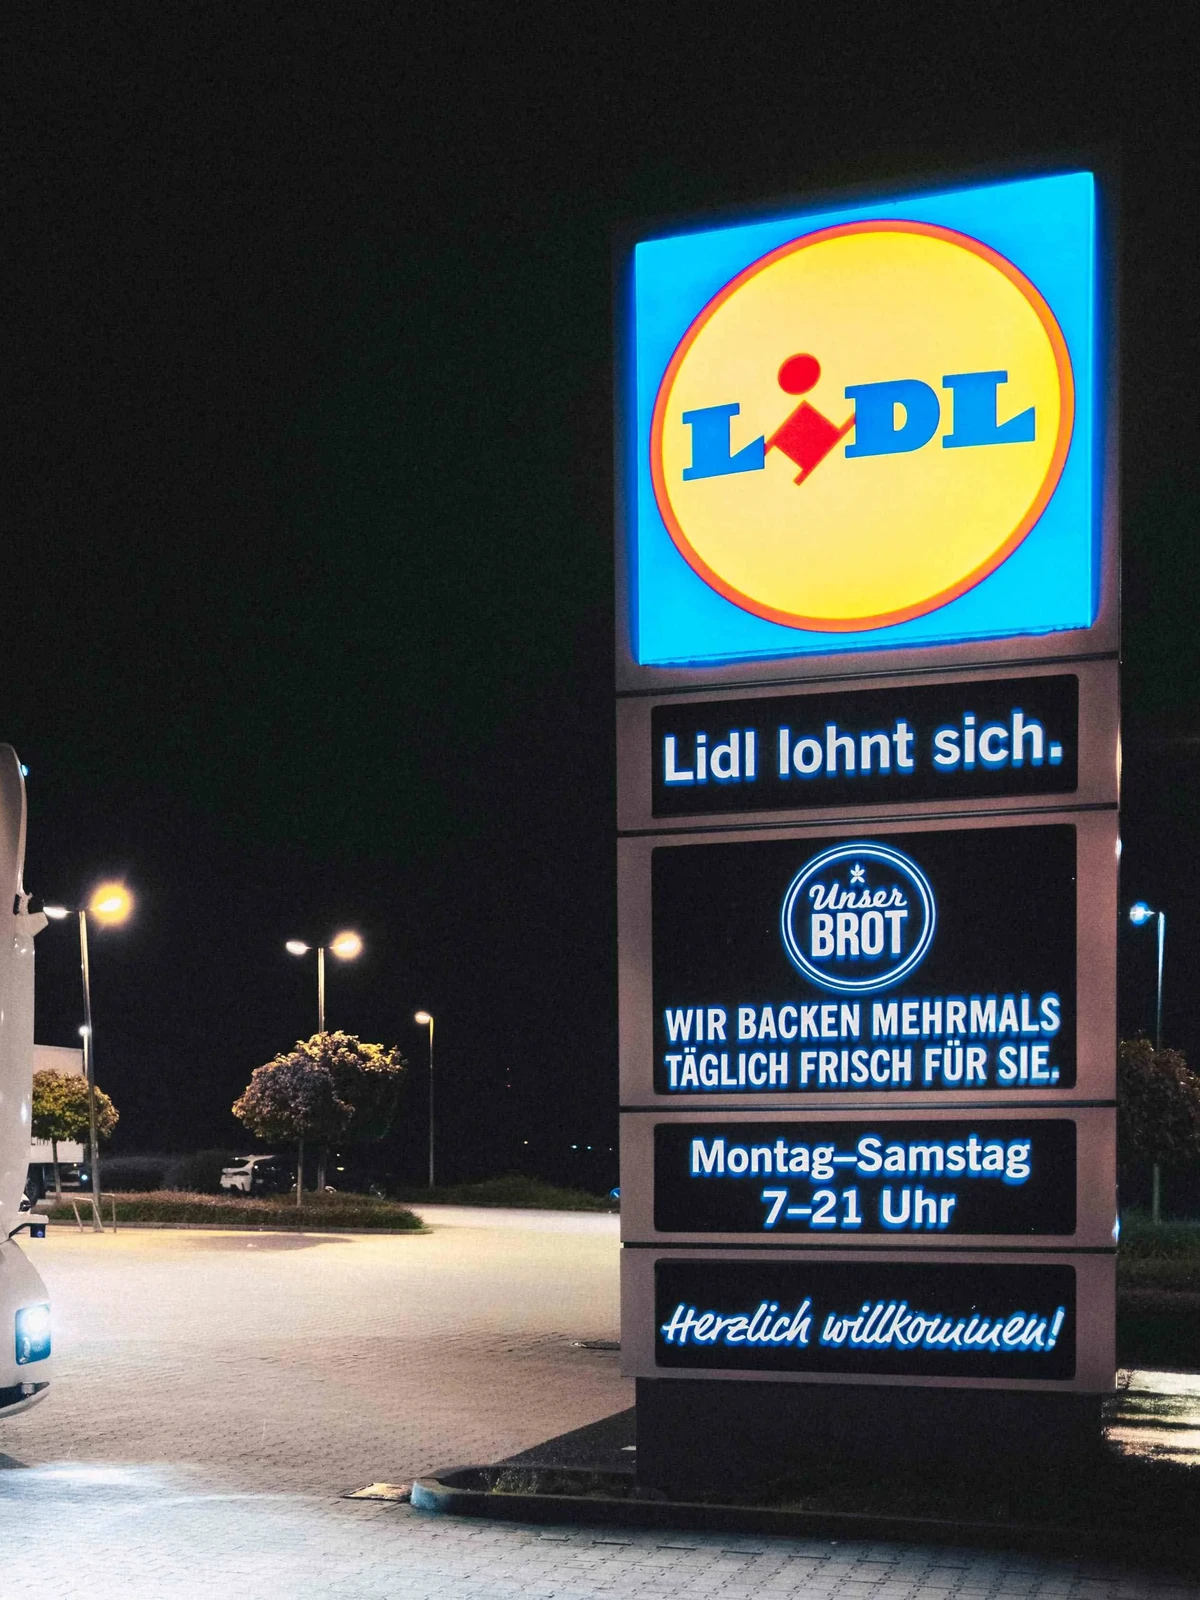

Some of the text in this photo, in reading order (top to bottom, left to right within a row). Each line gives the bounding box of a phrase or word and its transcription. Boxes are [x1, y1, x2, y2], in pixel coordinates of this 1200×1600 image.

[665, 713, 1062, 781] Lidl lohnt sich.
[809, 883, 907, 910] Unser
[811, 909, 908, 958] BROT
[665, 997, 1060, 1041] WIR BACKEN MEHRMALS
[665, 1039, 1060, 1086] TÄGLICH FRISCH FÜR SIE.
[763, 1190, 955, 1224] 7–21 Uhr
[663, 1301, 1065, 1347] Herzlich willkommen!
